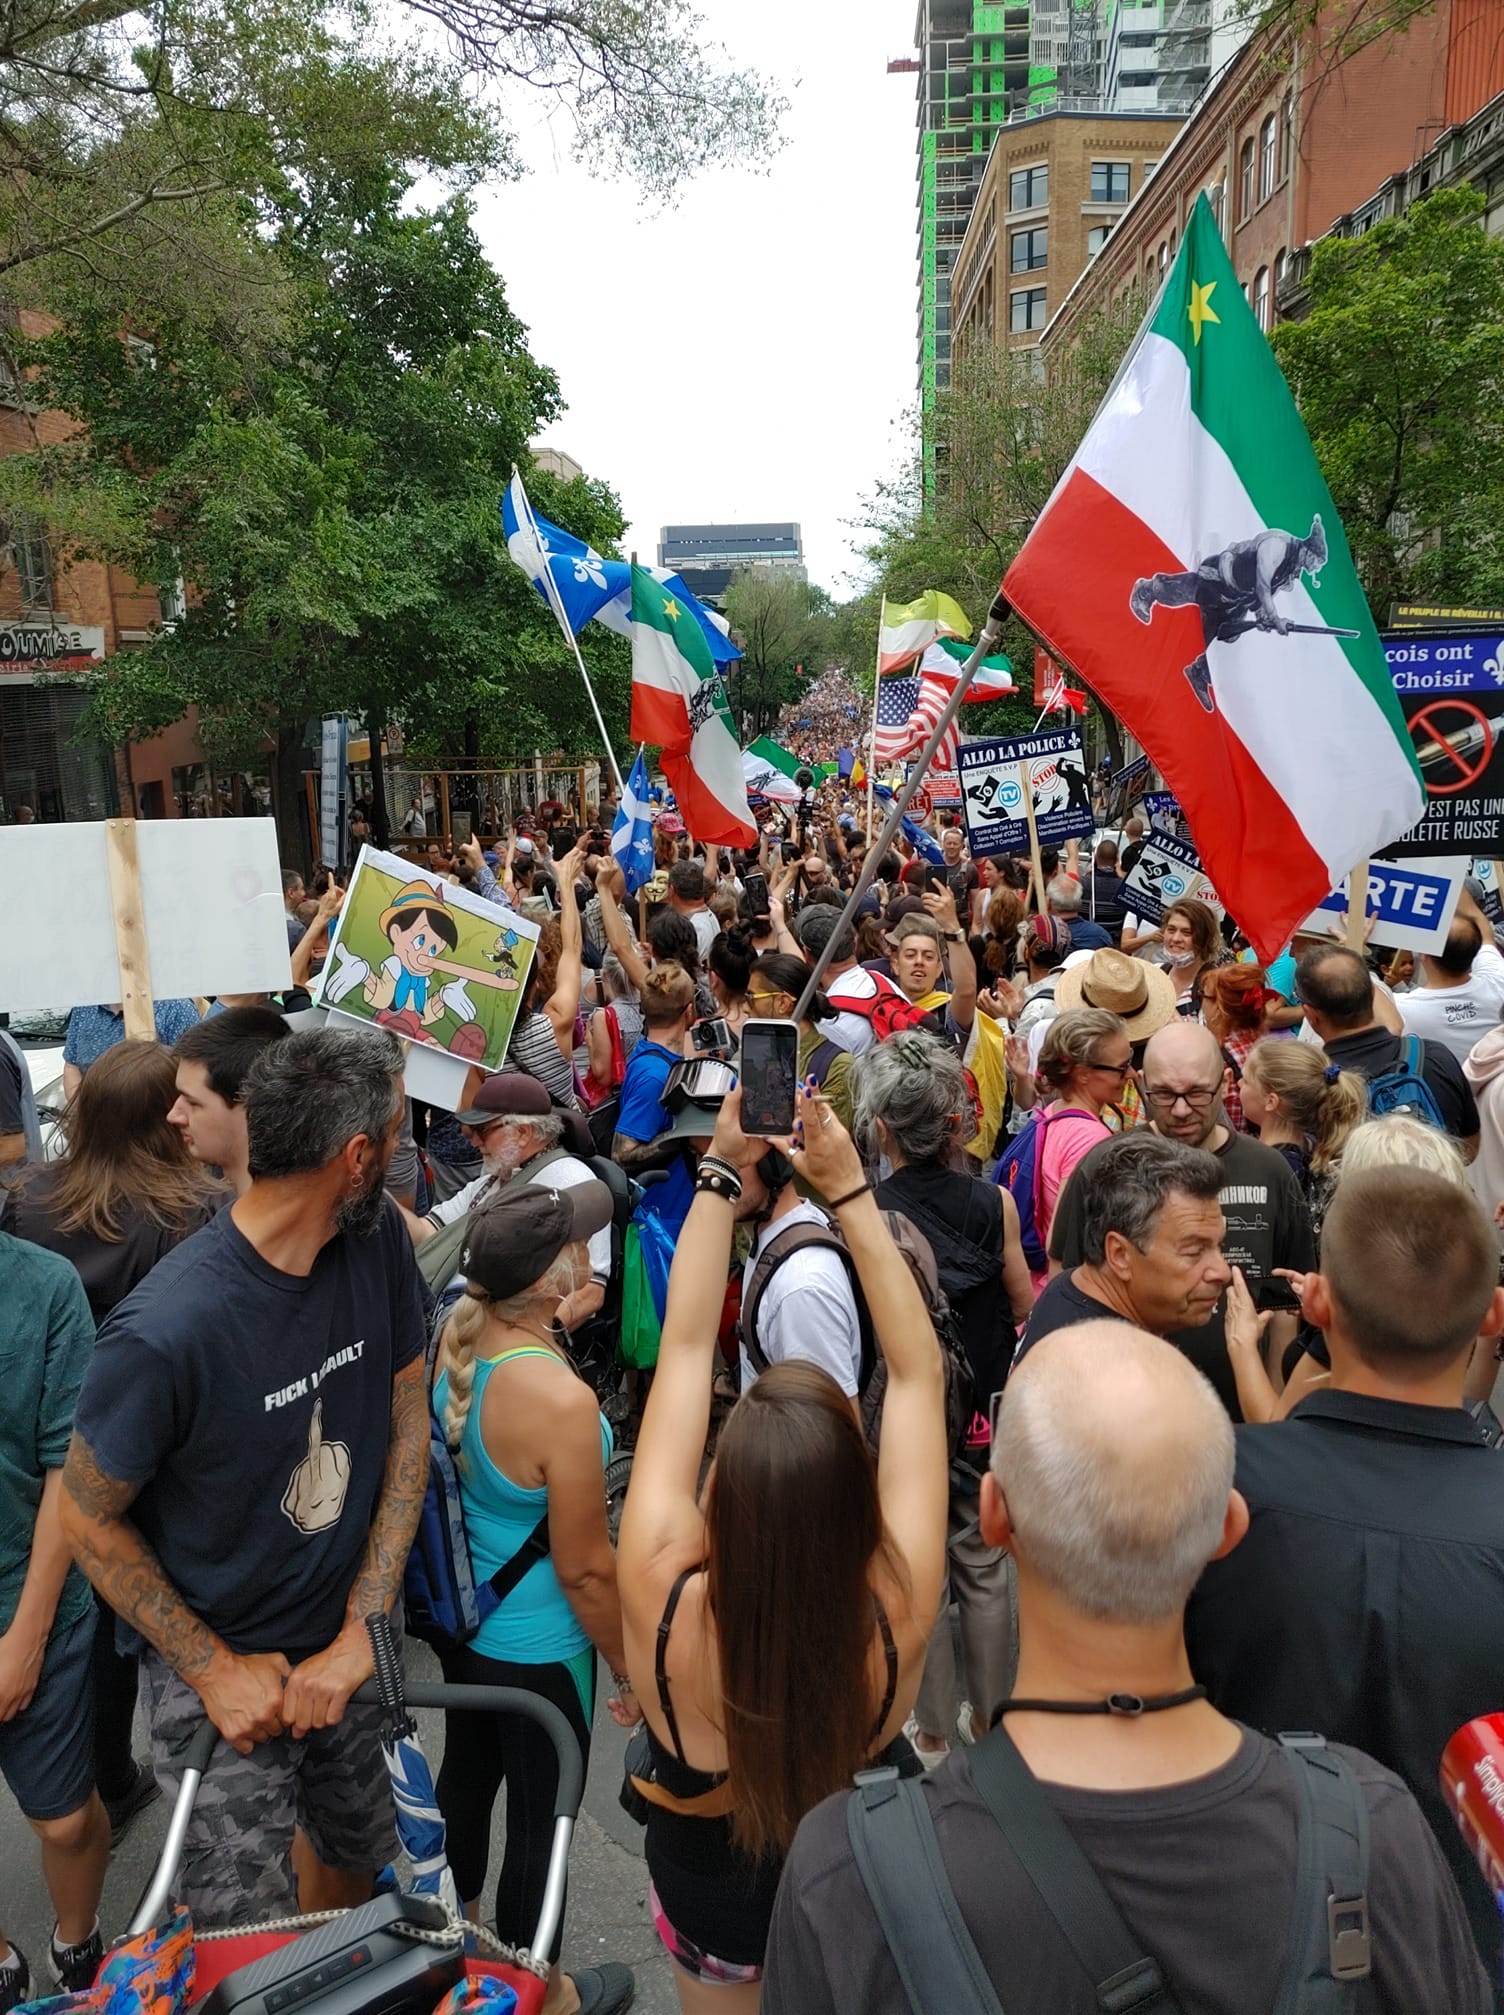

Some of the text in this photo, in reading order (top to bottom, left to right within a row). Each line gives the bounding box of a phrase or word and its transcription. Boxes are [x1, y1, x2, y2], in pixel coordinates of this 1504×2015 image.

[1409, 607, 1440, 617] PEUPLE
[1435, 643, 1474, 661] ont
[1392, 669, 1474, 689] Choisir
[962, 736, 1066, 767] ALLO LA POLICE
[1032, 764, 1057, 788] STOP
[1455, 799, 1480, 816] PAS
[1454, 820, 1500, 840] RUSSE
[1151, 835, 1200, 867] ALLO LA
[1445, 1002, 1475, 1014] PINCHE
[1448, 1010, 1476, 1023] COVID
[264, 1376, 308, 1413] FUCK
